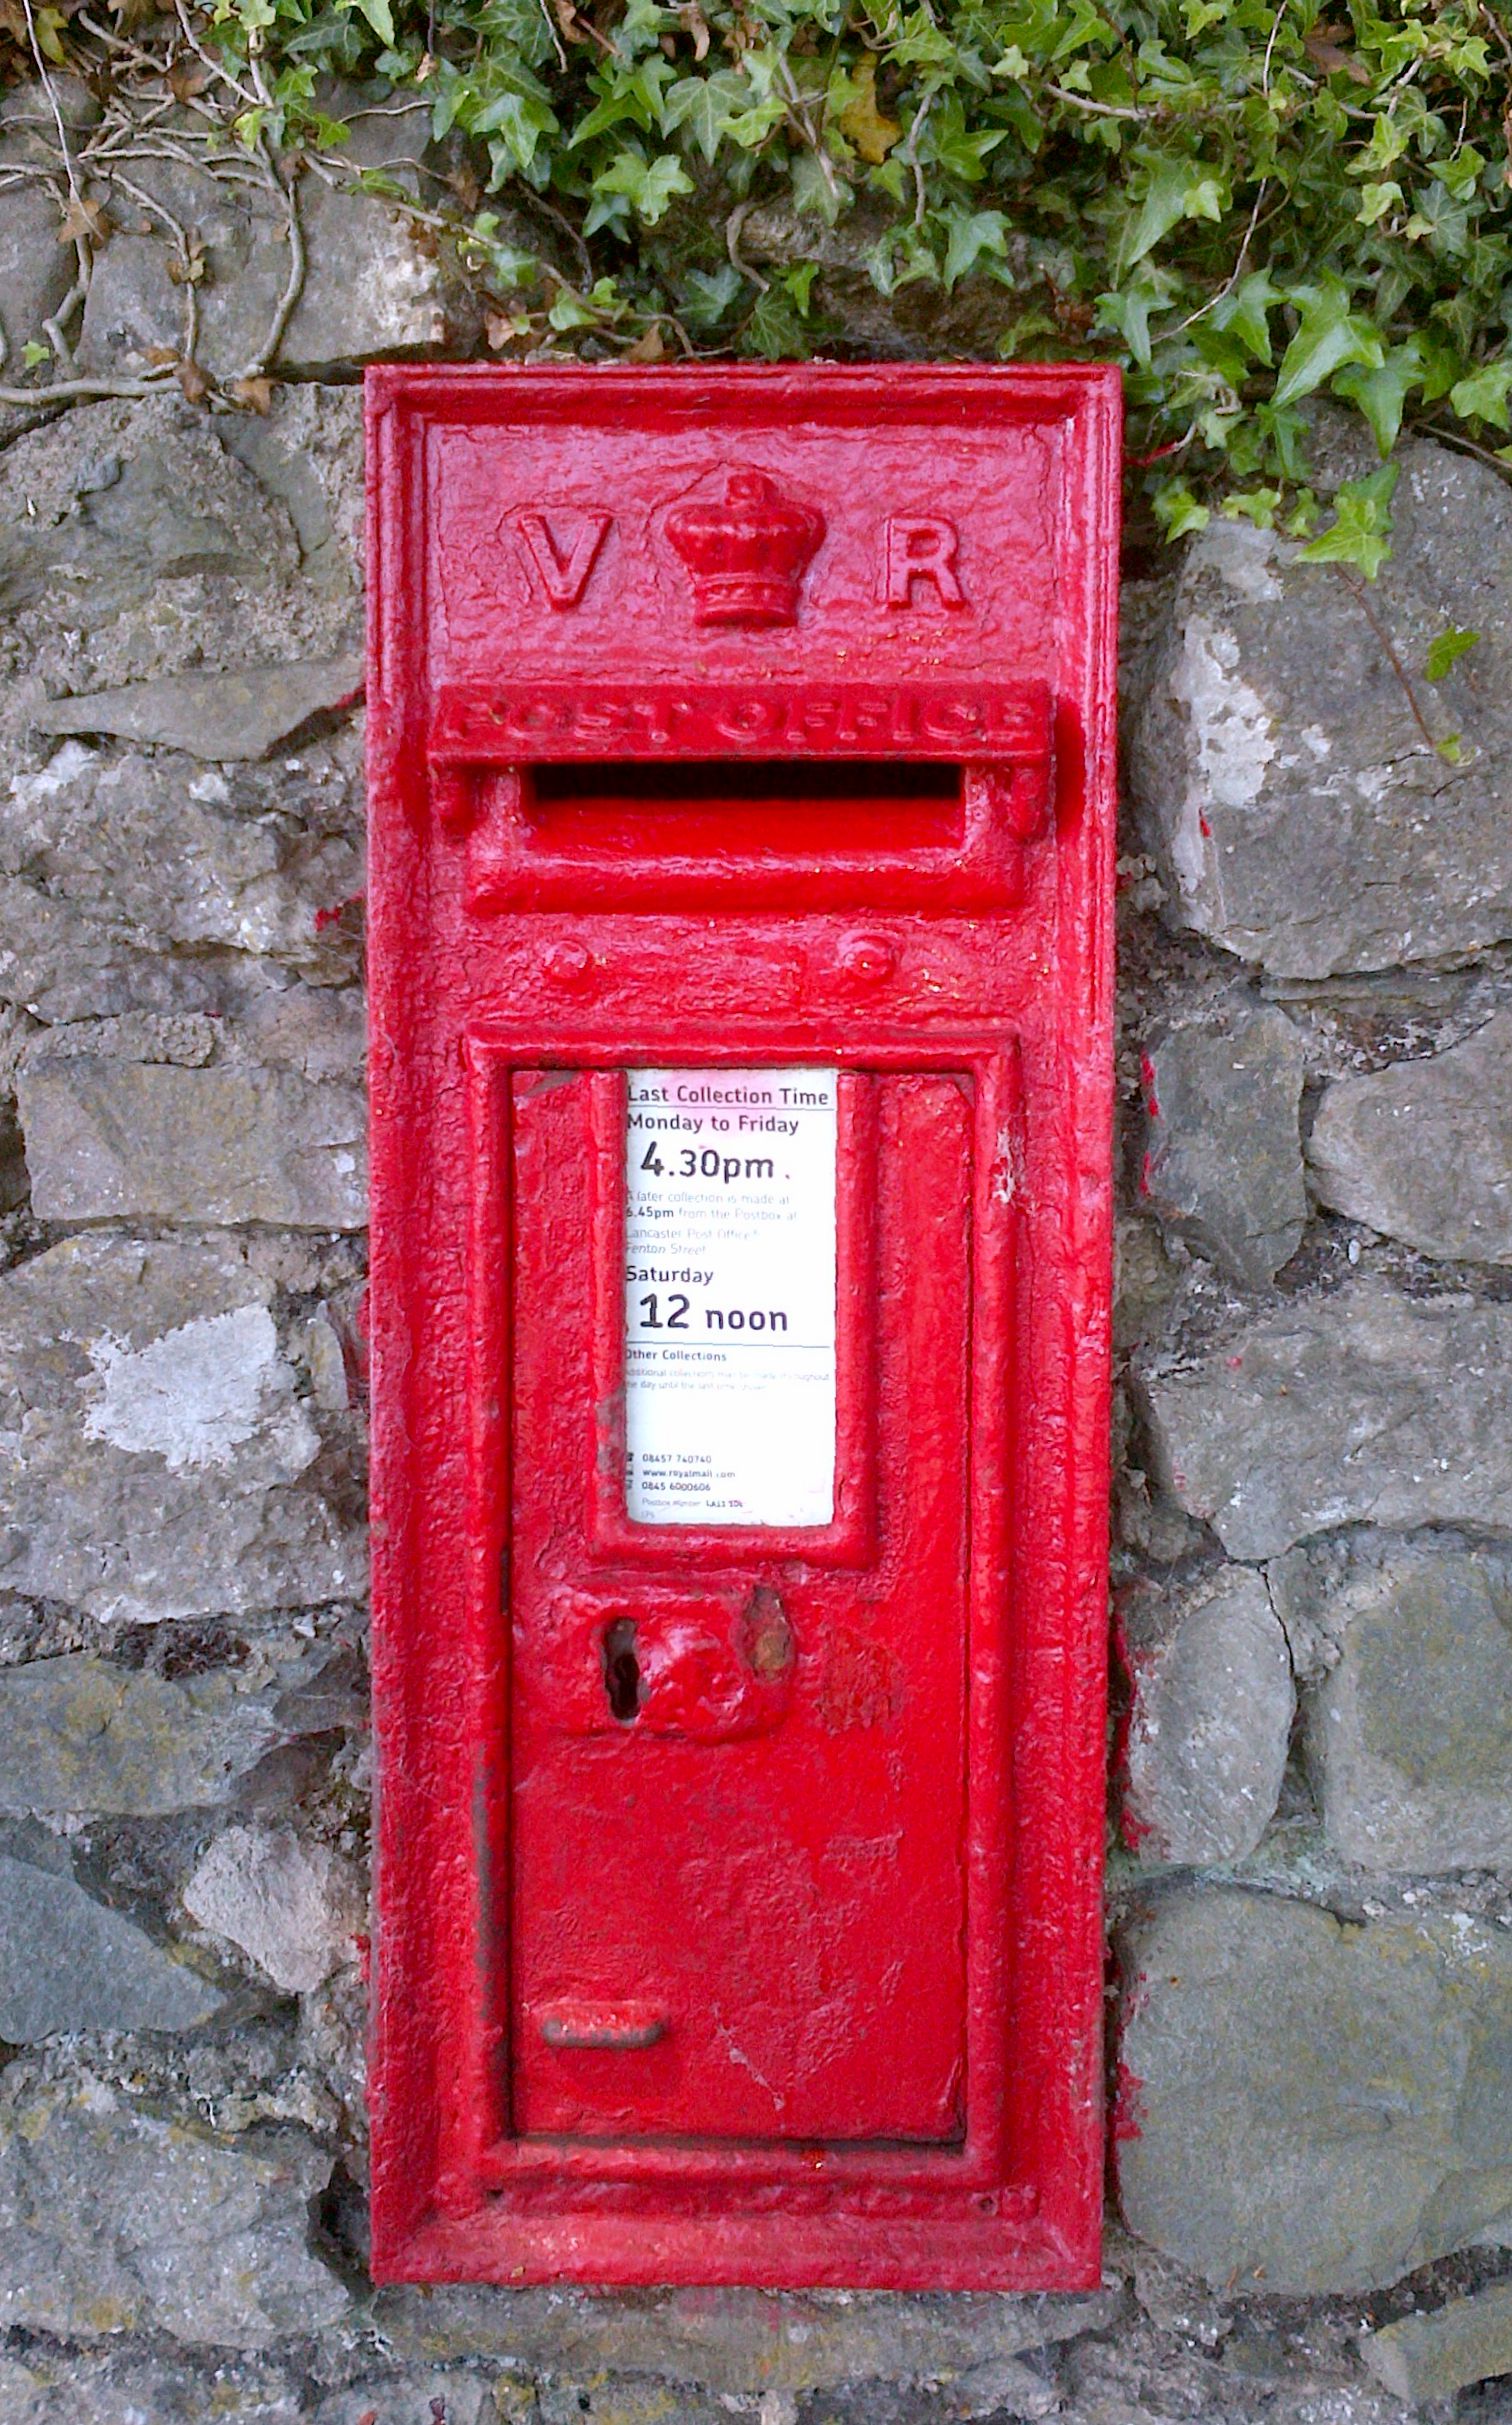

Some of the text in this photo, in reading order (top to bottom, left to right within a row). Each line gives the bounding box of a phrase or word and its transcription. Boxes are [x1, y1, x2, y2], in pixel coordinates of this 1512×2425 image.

[519, 512, 968, 612] V R
[442, 698, 1033, 743] POST OFFICE
[628, 1085, 829, 1105] Last Collection Time
[627, 1114, 799, 1136] Monday to Friday
[626, 1265, 714, 1286] Saturday
[640, 1293, 788, 1331] 12 noon
[662, 1349, 727, 1362] Collections
